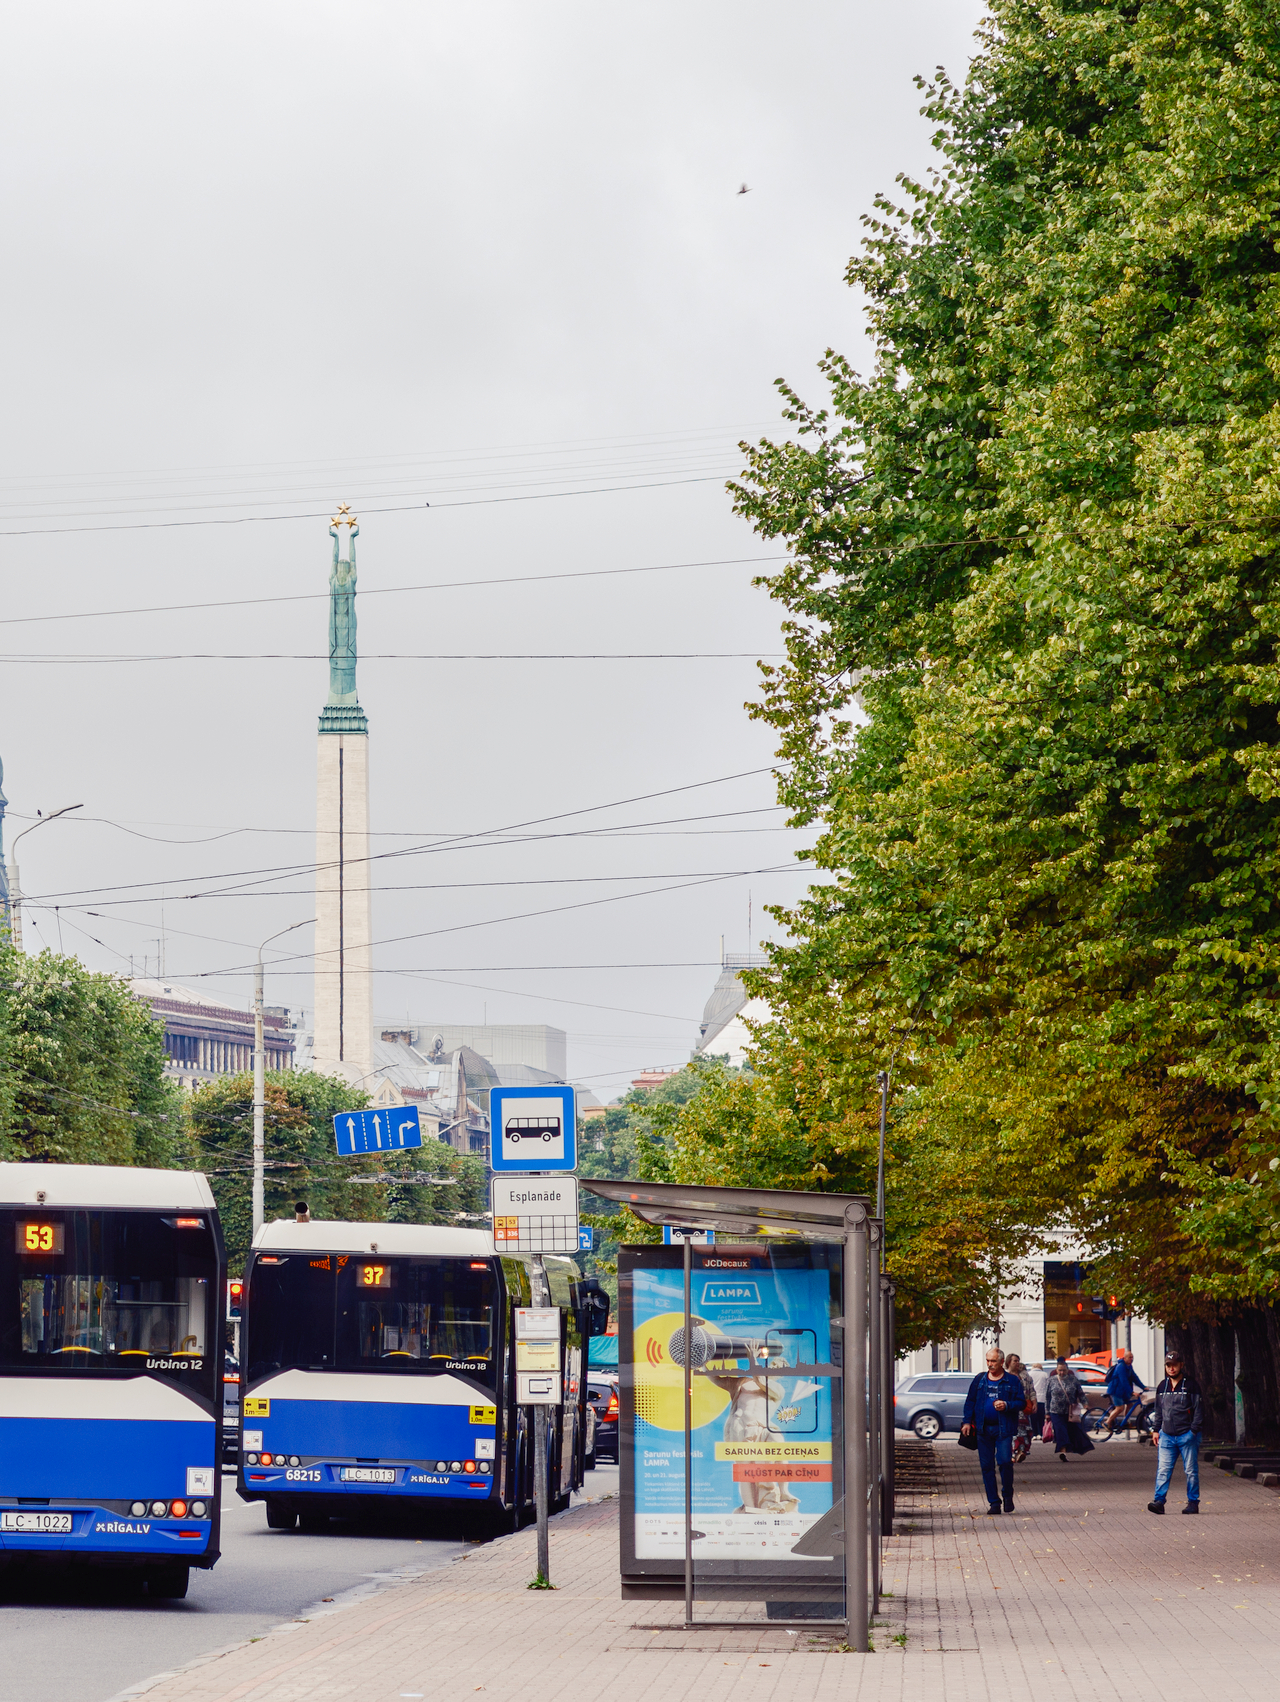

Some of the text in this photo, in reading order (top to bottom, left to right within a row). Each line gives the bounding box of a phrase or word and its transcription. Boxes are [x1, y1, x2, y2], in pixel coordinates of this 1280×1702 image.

[510, 1190, 561, 1204] Esplanāde
[26, 1226, 52, 1250] 53
[364, 1267, 384, 1284] 37
[710, 1289, 751, 1297] LAMPA
[146, 1358, 203, 1370] Urbino 12
[445, 1362, 476, 1370] Urbino
[784, 1448, 819, 1457] CIEŅAS
[286, 1470, 321, 1481] 68215
[348, 1470, 393, 1480] LC-1013
[744, 1468, 772, 1479] KĻŪST
[796, 1468, 820, 1479] CĪŅU
[418, 1475, 450, 1484] RĪGA.LV
[5, 1515, 69, 1528] LC-1022
[107, 1522, 151, 1534] RĪGA.LV
